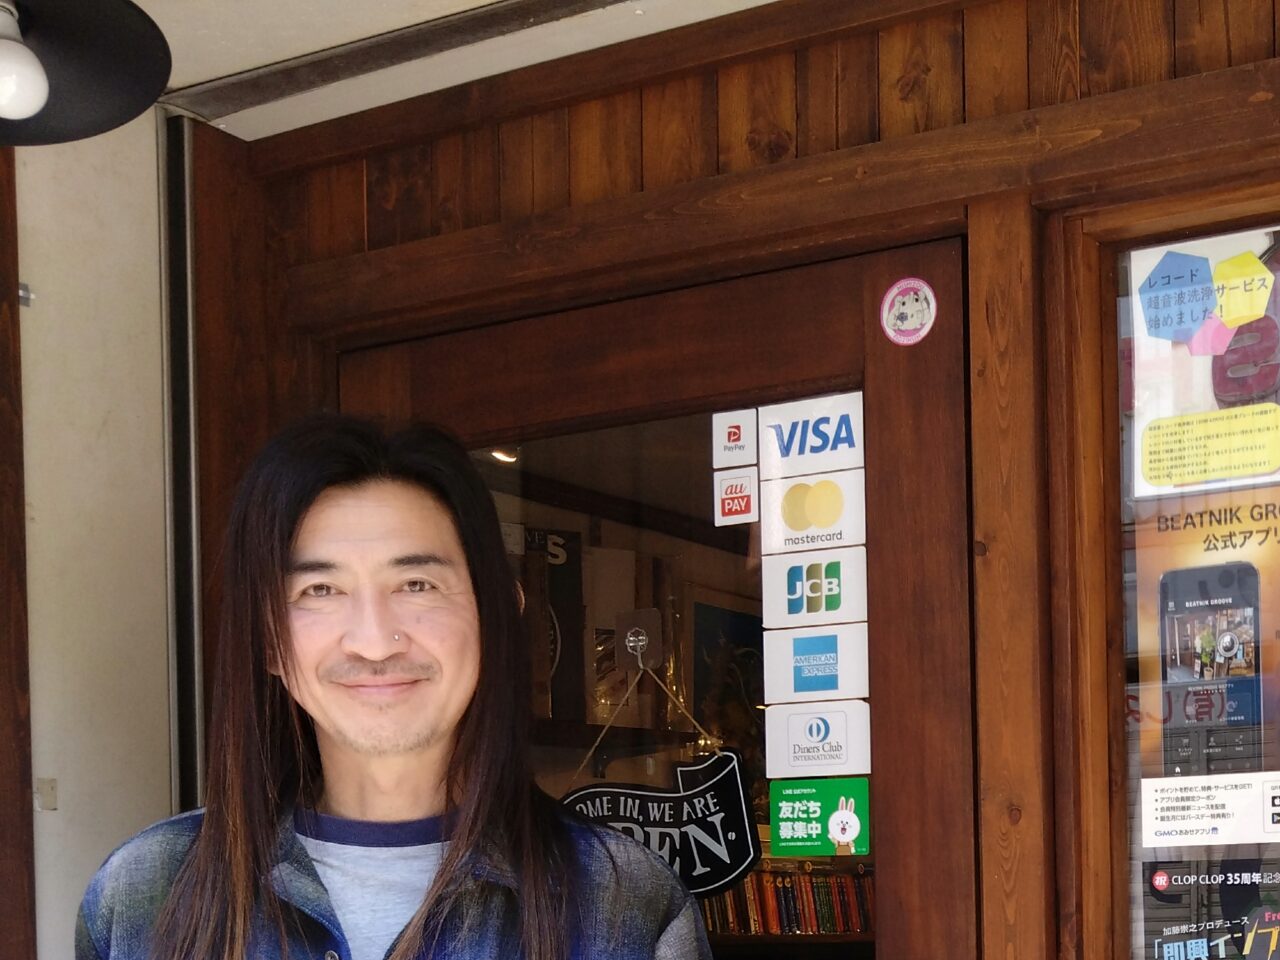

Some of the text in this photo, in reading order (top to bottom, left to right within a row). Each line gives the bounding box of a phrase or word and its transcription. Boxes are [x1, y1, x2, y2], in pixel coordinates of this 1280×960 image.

[1148, 269, 1199, 289] レコード
[766, 413, 856, 458] VISA
[724, 443, 745, 452] PayPay
[725, 482, 747, 496] au
[724, 498, 748, 513] PAY
[1157, 508, 1242, 533] BEATNIK
[785, 531, 842, 546] mastercard
[802, 664, 838, 676] EXPRESS
[793, 741, 843, 754] Diners Club
[793, 753, 843, 762] INTERNATIONAL
[648, 802, 673, 822] WE
[682, 791, 720, 821] ARE
[779, 800, 821, 818] 友だち
[779, 820, 821, 839] 募集中
[1172, 875, 1197, 885] CLOP
[1200, 874, 1225, 885] CLOP
